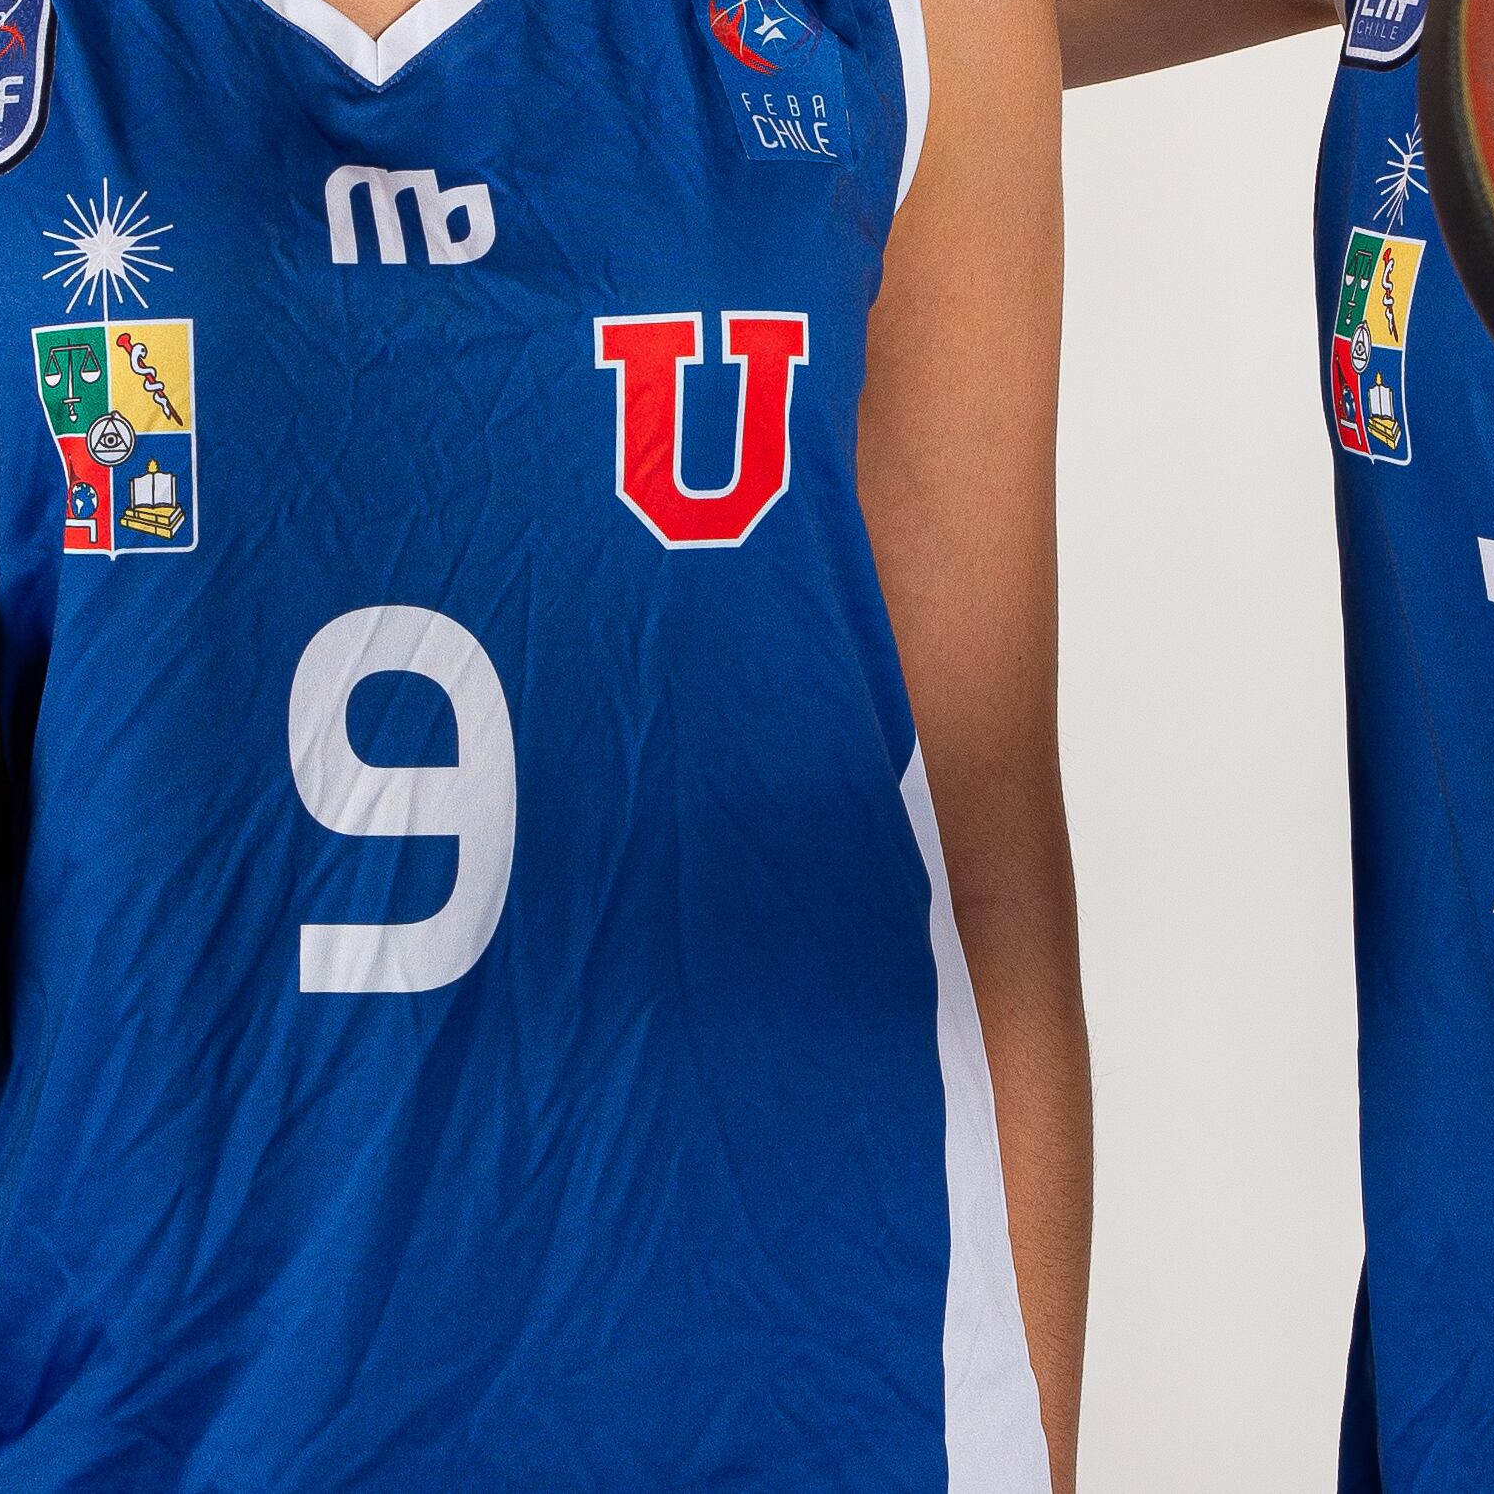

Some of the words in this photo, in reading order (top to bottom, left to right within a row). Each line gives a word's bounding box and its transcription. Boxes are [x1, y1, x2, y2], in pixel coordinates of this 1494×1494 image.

[1356, 19, 1400, 41] CHILE
[740, 91, 827, 119] FEBA
[751, 114, 838, 158] CHILE
[593, 310, 810, 550] U
[288, 604, 516, 993] 9
